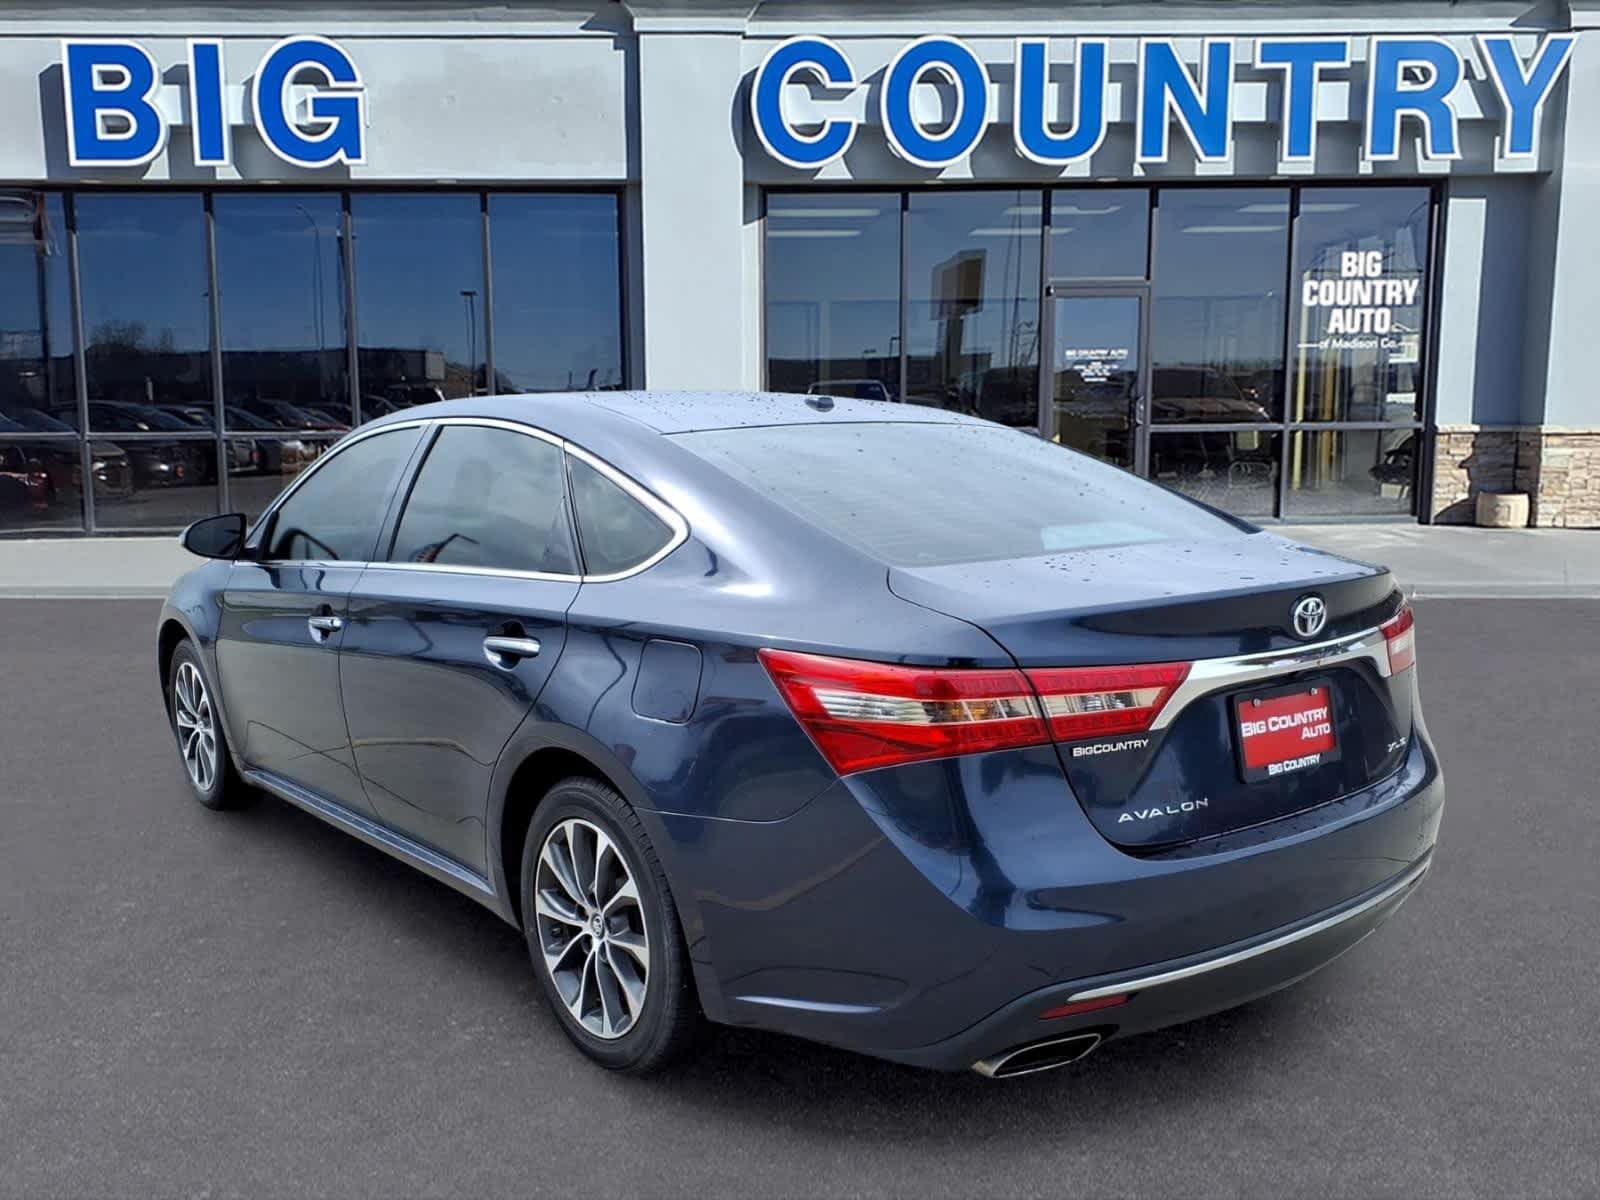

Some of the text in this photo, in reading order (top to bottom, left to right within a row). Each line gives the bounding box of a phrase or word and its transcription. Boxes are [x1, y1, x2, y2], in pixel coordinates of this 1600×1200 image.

[61, 33, 1576, 170] BIG COUNTRY
[1341, 250, 1383, 278] BIG
[1302, 279, 1420, 306] COUNTRY
[1327, 307, 1392, 334] AUTO
[1331, 336, 1379, 349] Madison
[1117, 797, 1209, 823] AVALON
